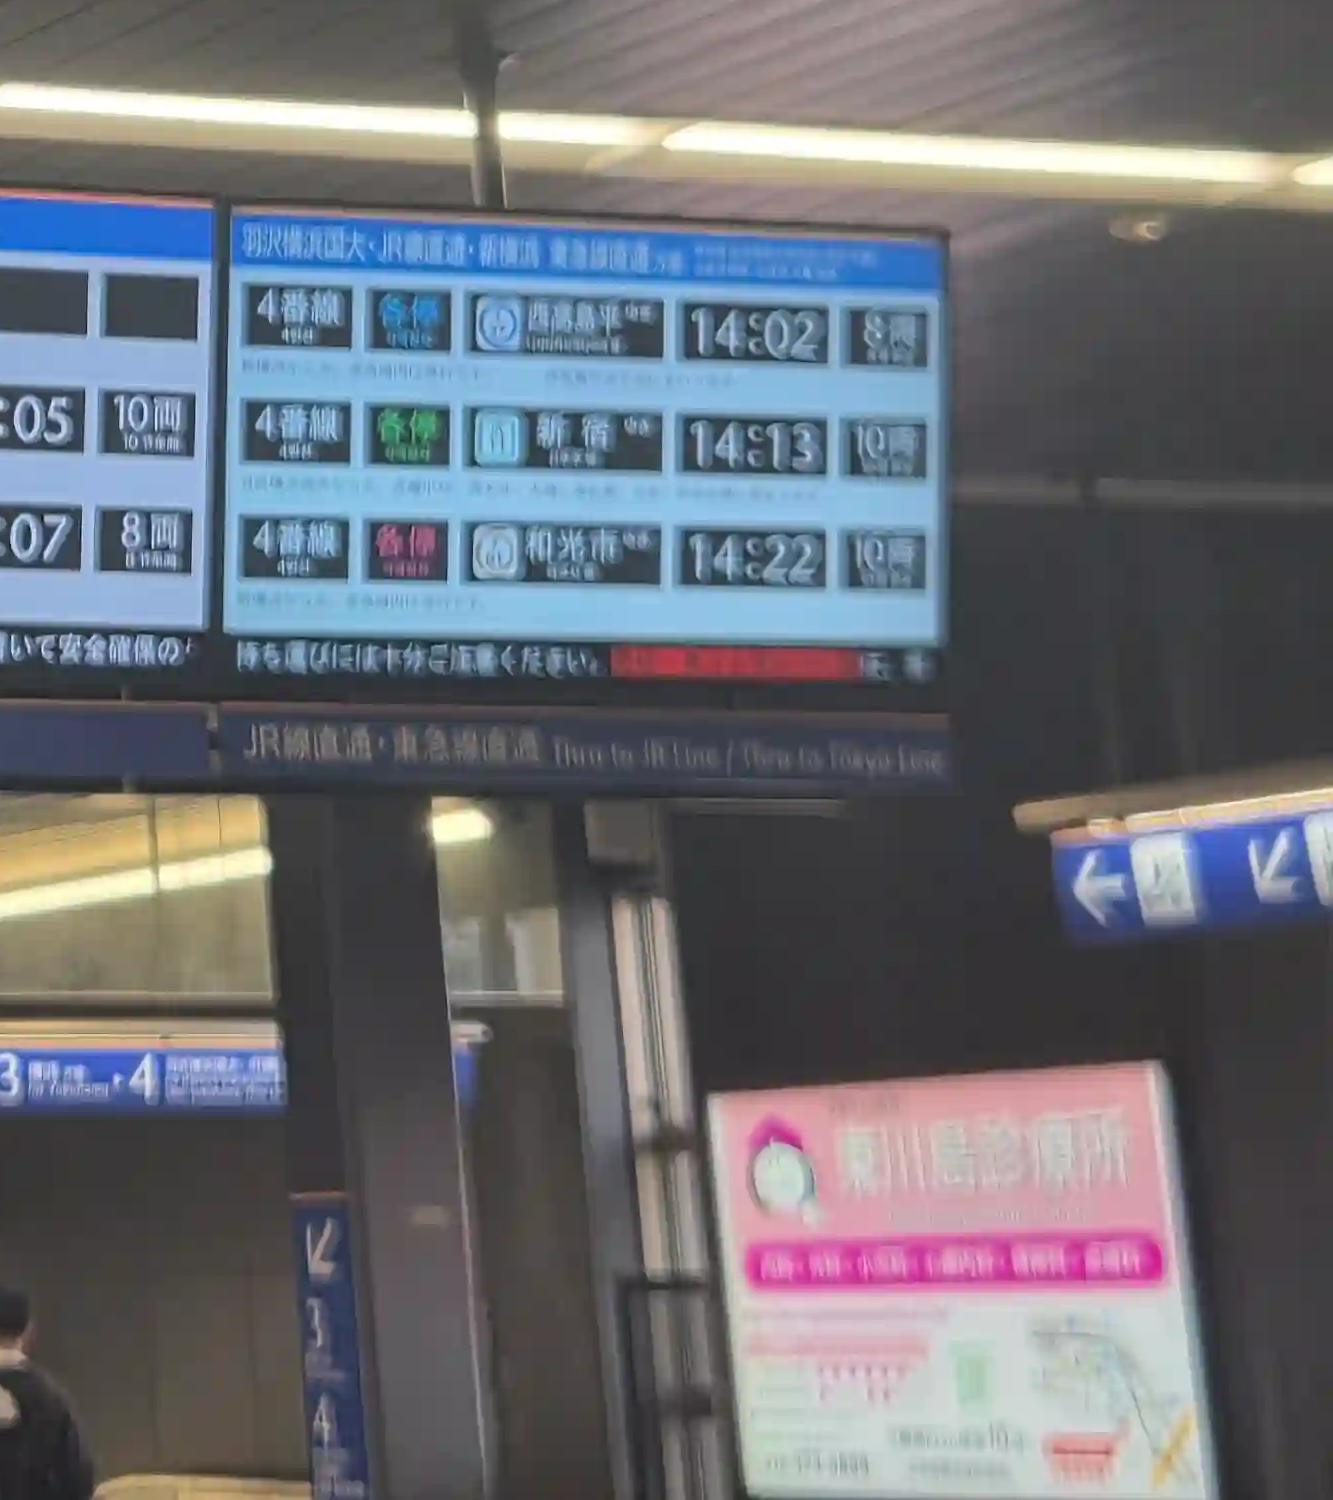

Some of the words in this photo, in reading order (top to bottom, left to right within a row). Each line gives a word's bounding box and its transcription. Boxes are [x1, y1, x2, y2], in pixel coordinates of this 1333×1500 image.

[690, 306, 825, 362] 14:02
[690, 419, 824, 472] 14:13
[689, 532, 823, 587] 14:22
[129, 1052, 160, 1106] 4
